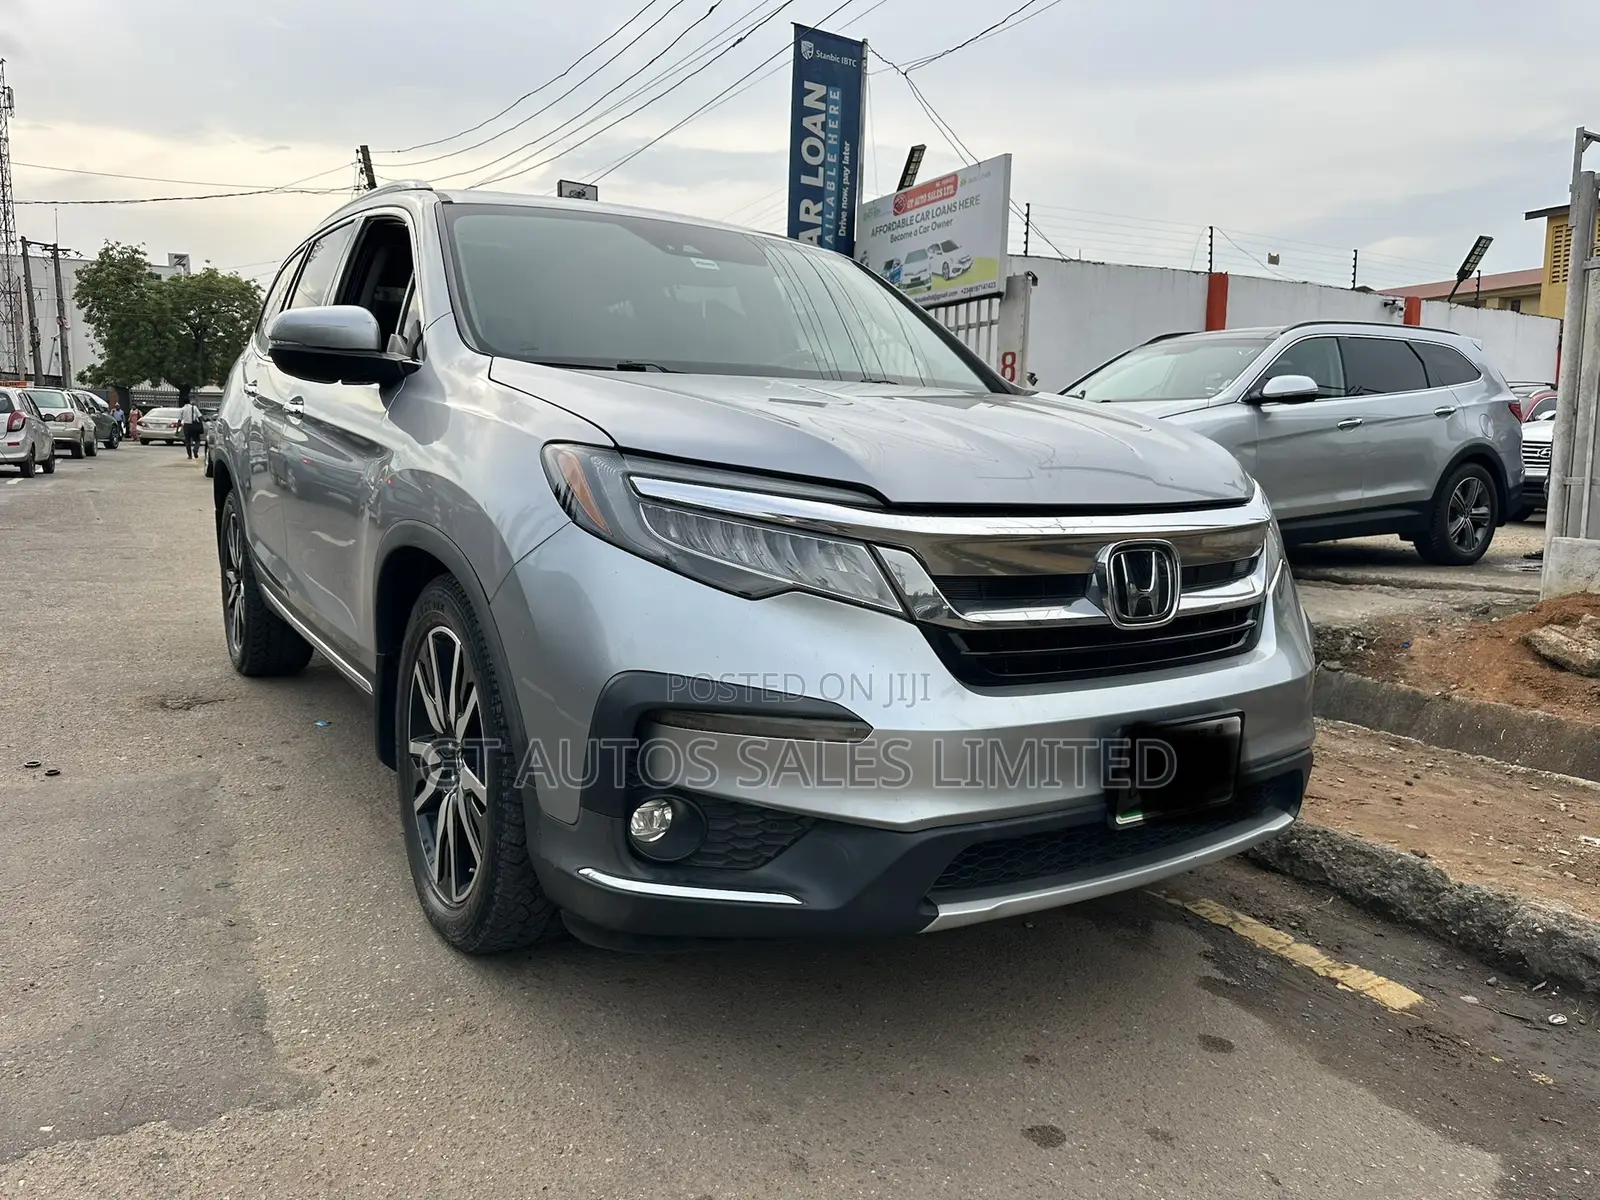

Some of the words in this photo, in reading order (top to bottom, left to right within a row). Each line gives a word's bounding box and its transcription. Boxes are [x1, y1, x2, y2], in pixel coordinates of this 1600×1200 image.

[816, 50, 840, 63] Stanbic
[841, 58, 857, 67] IBTC
[828, 90, 840, 145] HERE
[800, 80, 827, 187] LOAN
[842, 166, 851, 185] pay
[825, 153, 837, 244] AILABLE
[927, 187, 943, 201] SALES
[798, 198, 823, 247] AR
[838, 210, 848, 237] Drive
[871, 216, 914, 237] AFFORDABLE
[915, 211, 931, 224] CAR
[932, 201, 957, 221] LOANS
[959, 195, 980, 210] HERE
[889, 229, 914, 243] Become
[918, 224, 930, 235] Car
[931, 218, 954, 232] Owner
[1001, 352, 1016, 382] 8
